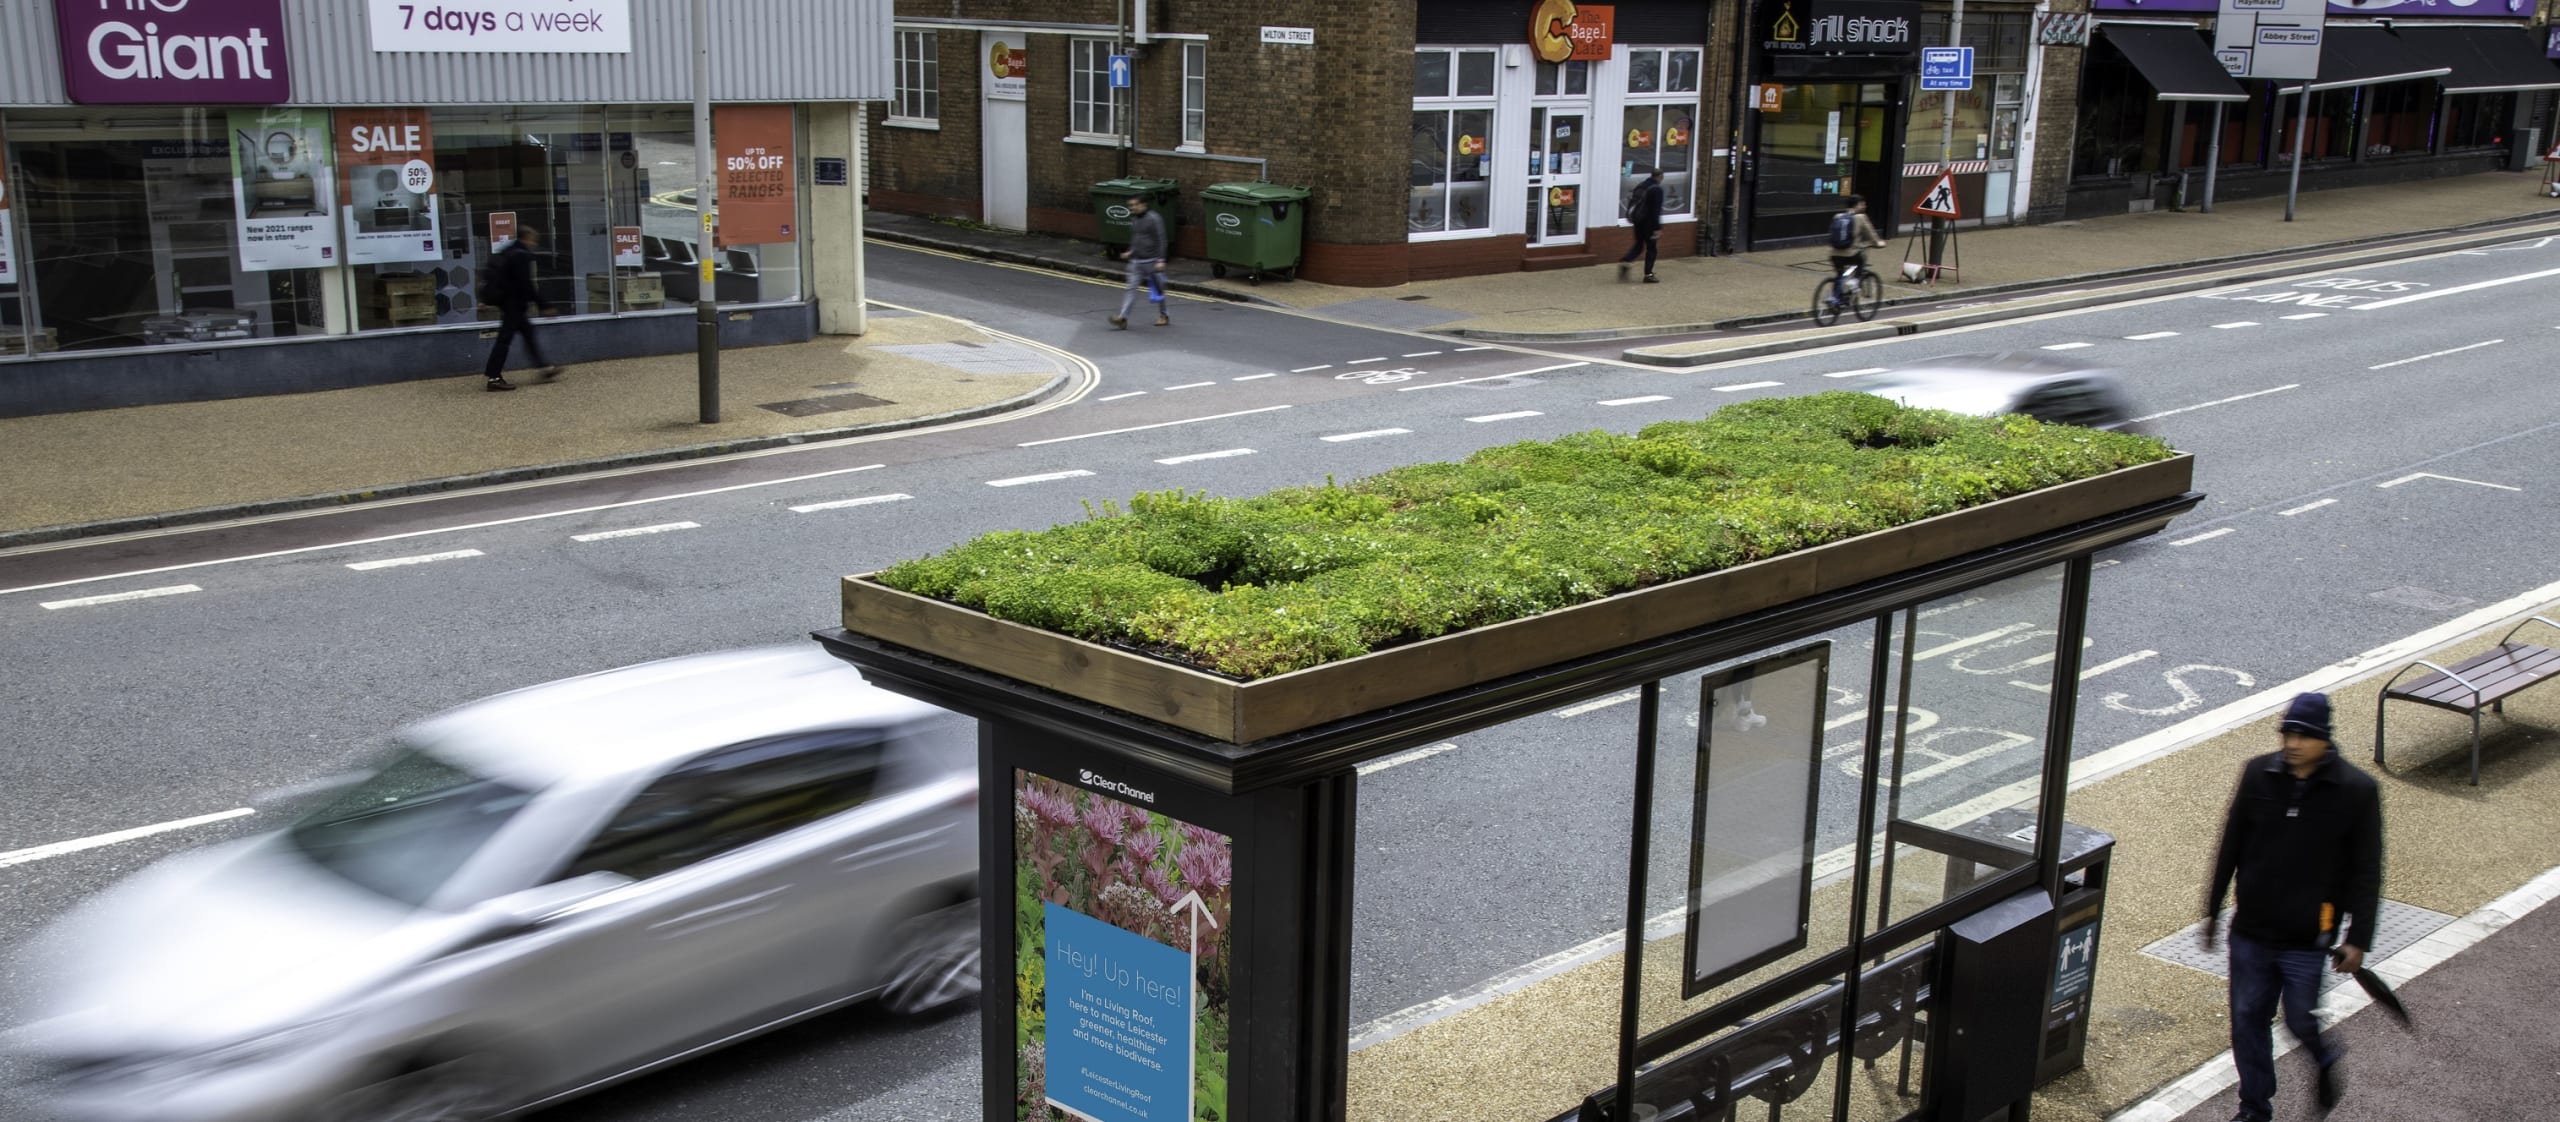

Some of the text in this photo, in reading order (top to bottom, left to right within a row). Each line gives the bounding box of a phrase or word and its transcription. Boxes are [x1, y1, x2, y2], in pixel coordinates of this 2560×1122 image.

[399, 5, 603, 36] 7 days a week
[1581, 10, 1600, 23] The
[1264, 30, 1311, 40] WILTON STREET
[1571, 23, 1607, 43] Bagel
[2046, 29, 2079, 41] Salon
[2263, 33, 2315, 41] Abbey Street
[87, 21, 272, 80] Giant
[351, 125, 422, 152] SALE
[408, 168, 427, 177] 50%
[727, 156, 783, 170] 50% OFF
[409, 178, 426, 186] OFF
[728, 170, 783, 183] SELECTED
[728, 183, 784, 198] RANGES
[287, 224, 313, 232] ranges
[616, 235, 638, 243] SALE
[2291, 278, 2431, 292] BUS
[2196, 289, 2383, 308] LANE
[1093, 774, 1154, 803] Clear Channel
[1057, 939, 1181, 1008] Hey! Up here!
[1081, 988, 1155, 1028] I'm a Living Roof,
[1069, 997, 1168, 1046] here to make Leicester
[1079, 1017, 1156, 1055] greener, healthier
[1073, 1028, 1163, 1072] and more biodiverse.
[1081, 1066, 1152, 1103] #LeicesterLivingRoof
[1083, 1085, 1148, 1119] clearchannel.co.uk
